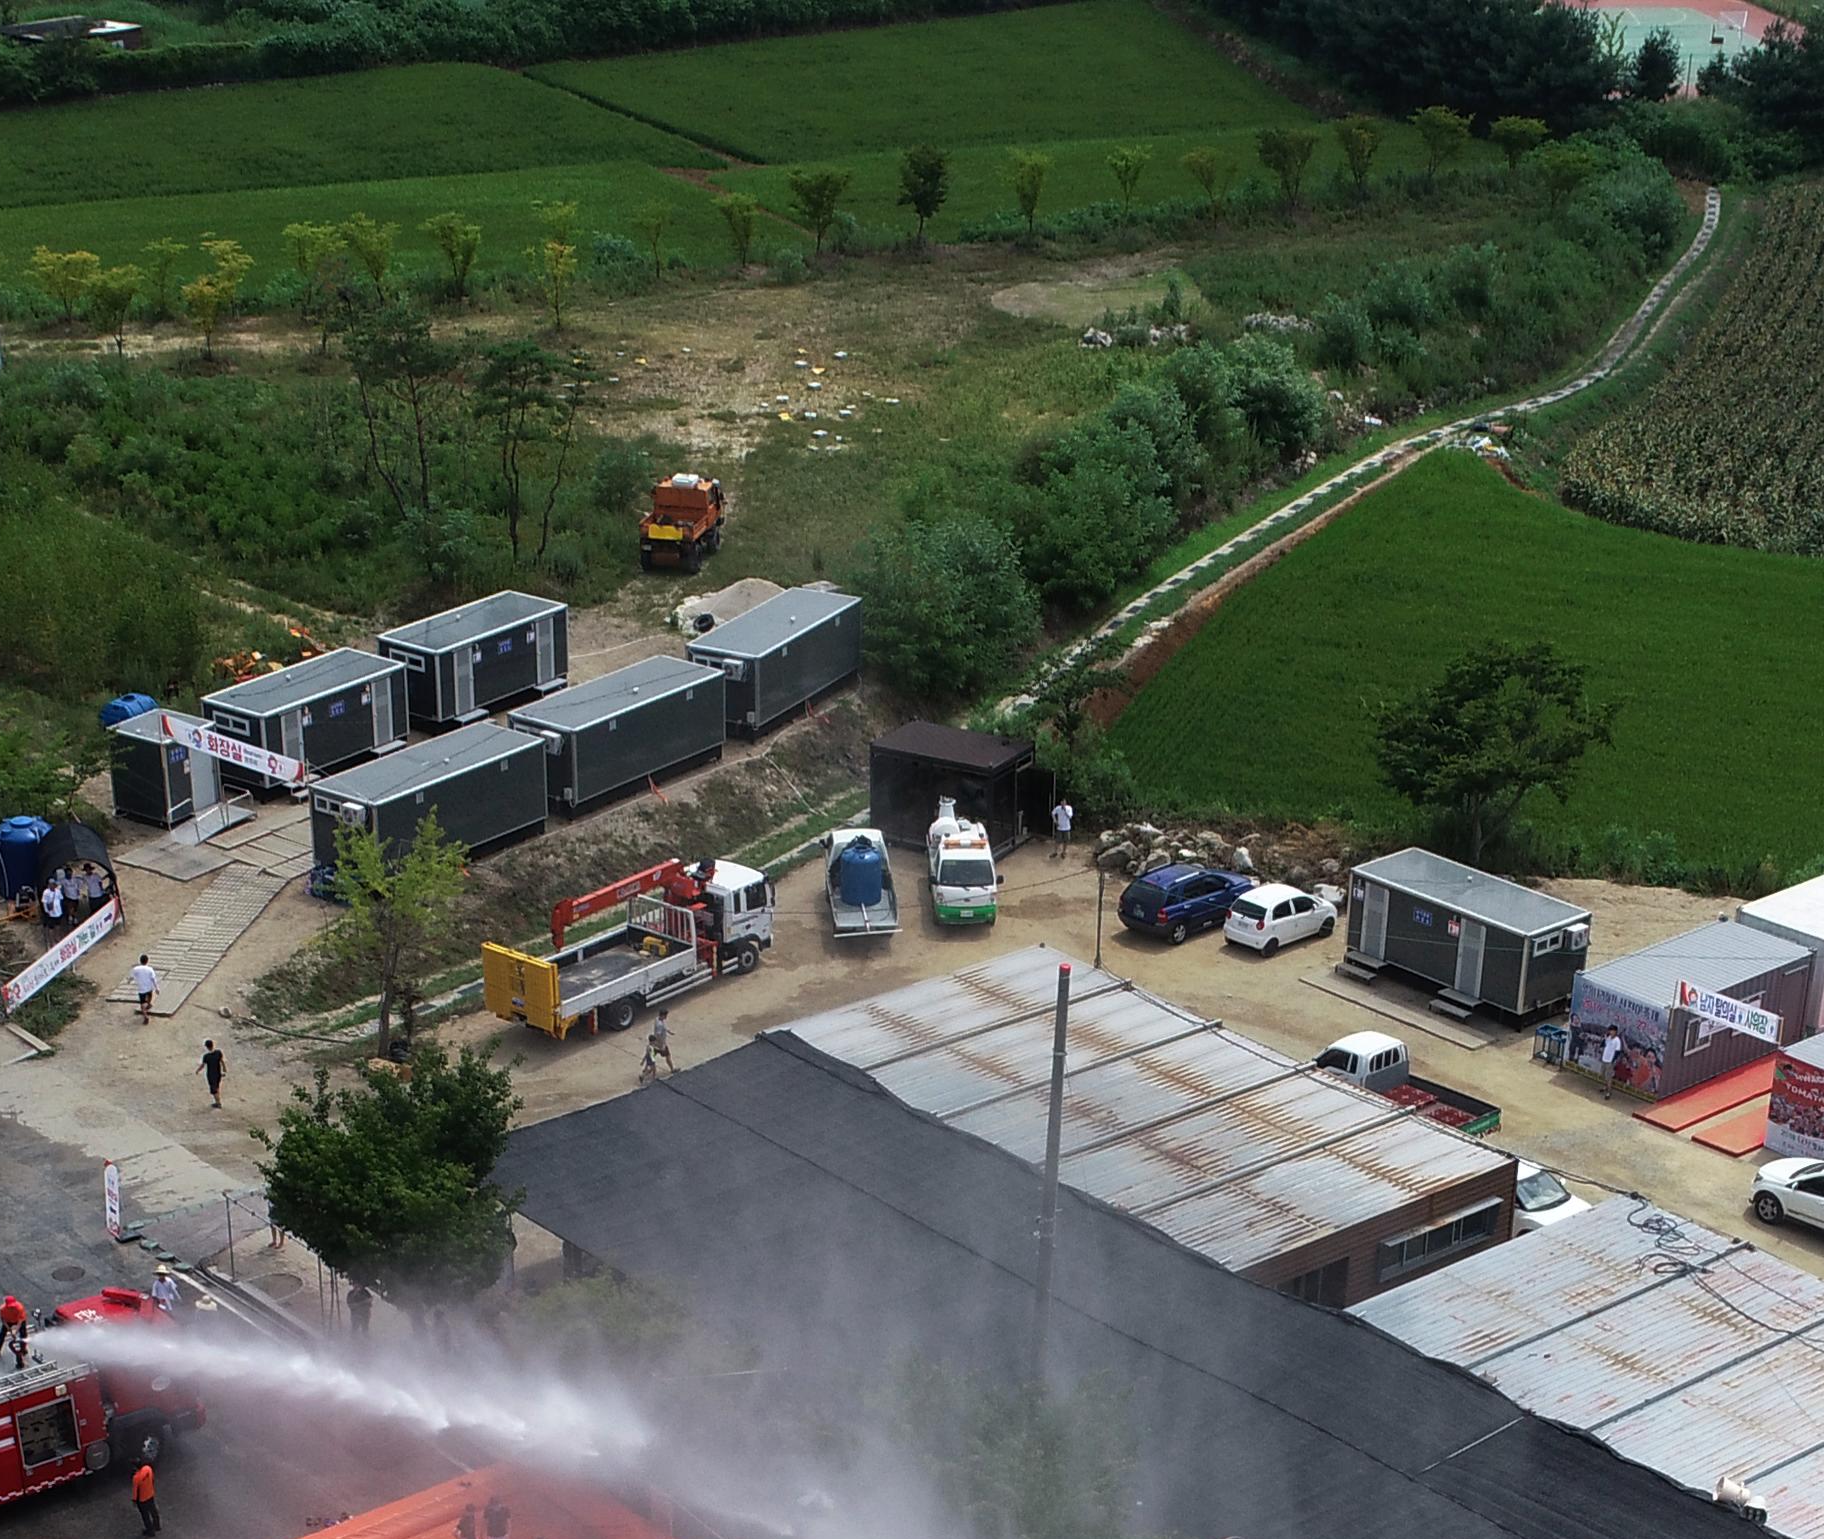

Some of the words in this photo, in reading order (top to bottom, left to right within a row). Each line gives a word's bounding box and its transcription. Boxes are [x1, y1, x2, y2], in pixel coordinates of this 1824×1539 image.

[207, 734, 244, 764] 화장실
[1699, 991, 1715, 1016] 남자
[1714, 997, 1738, 1024] 탈의실
